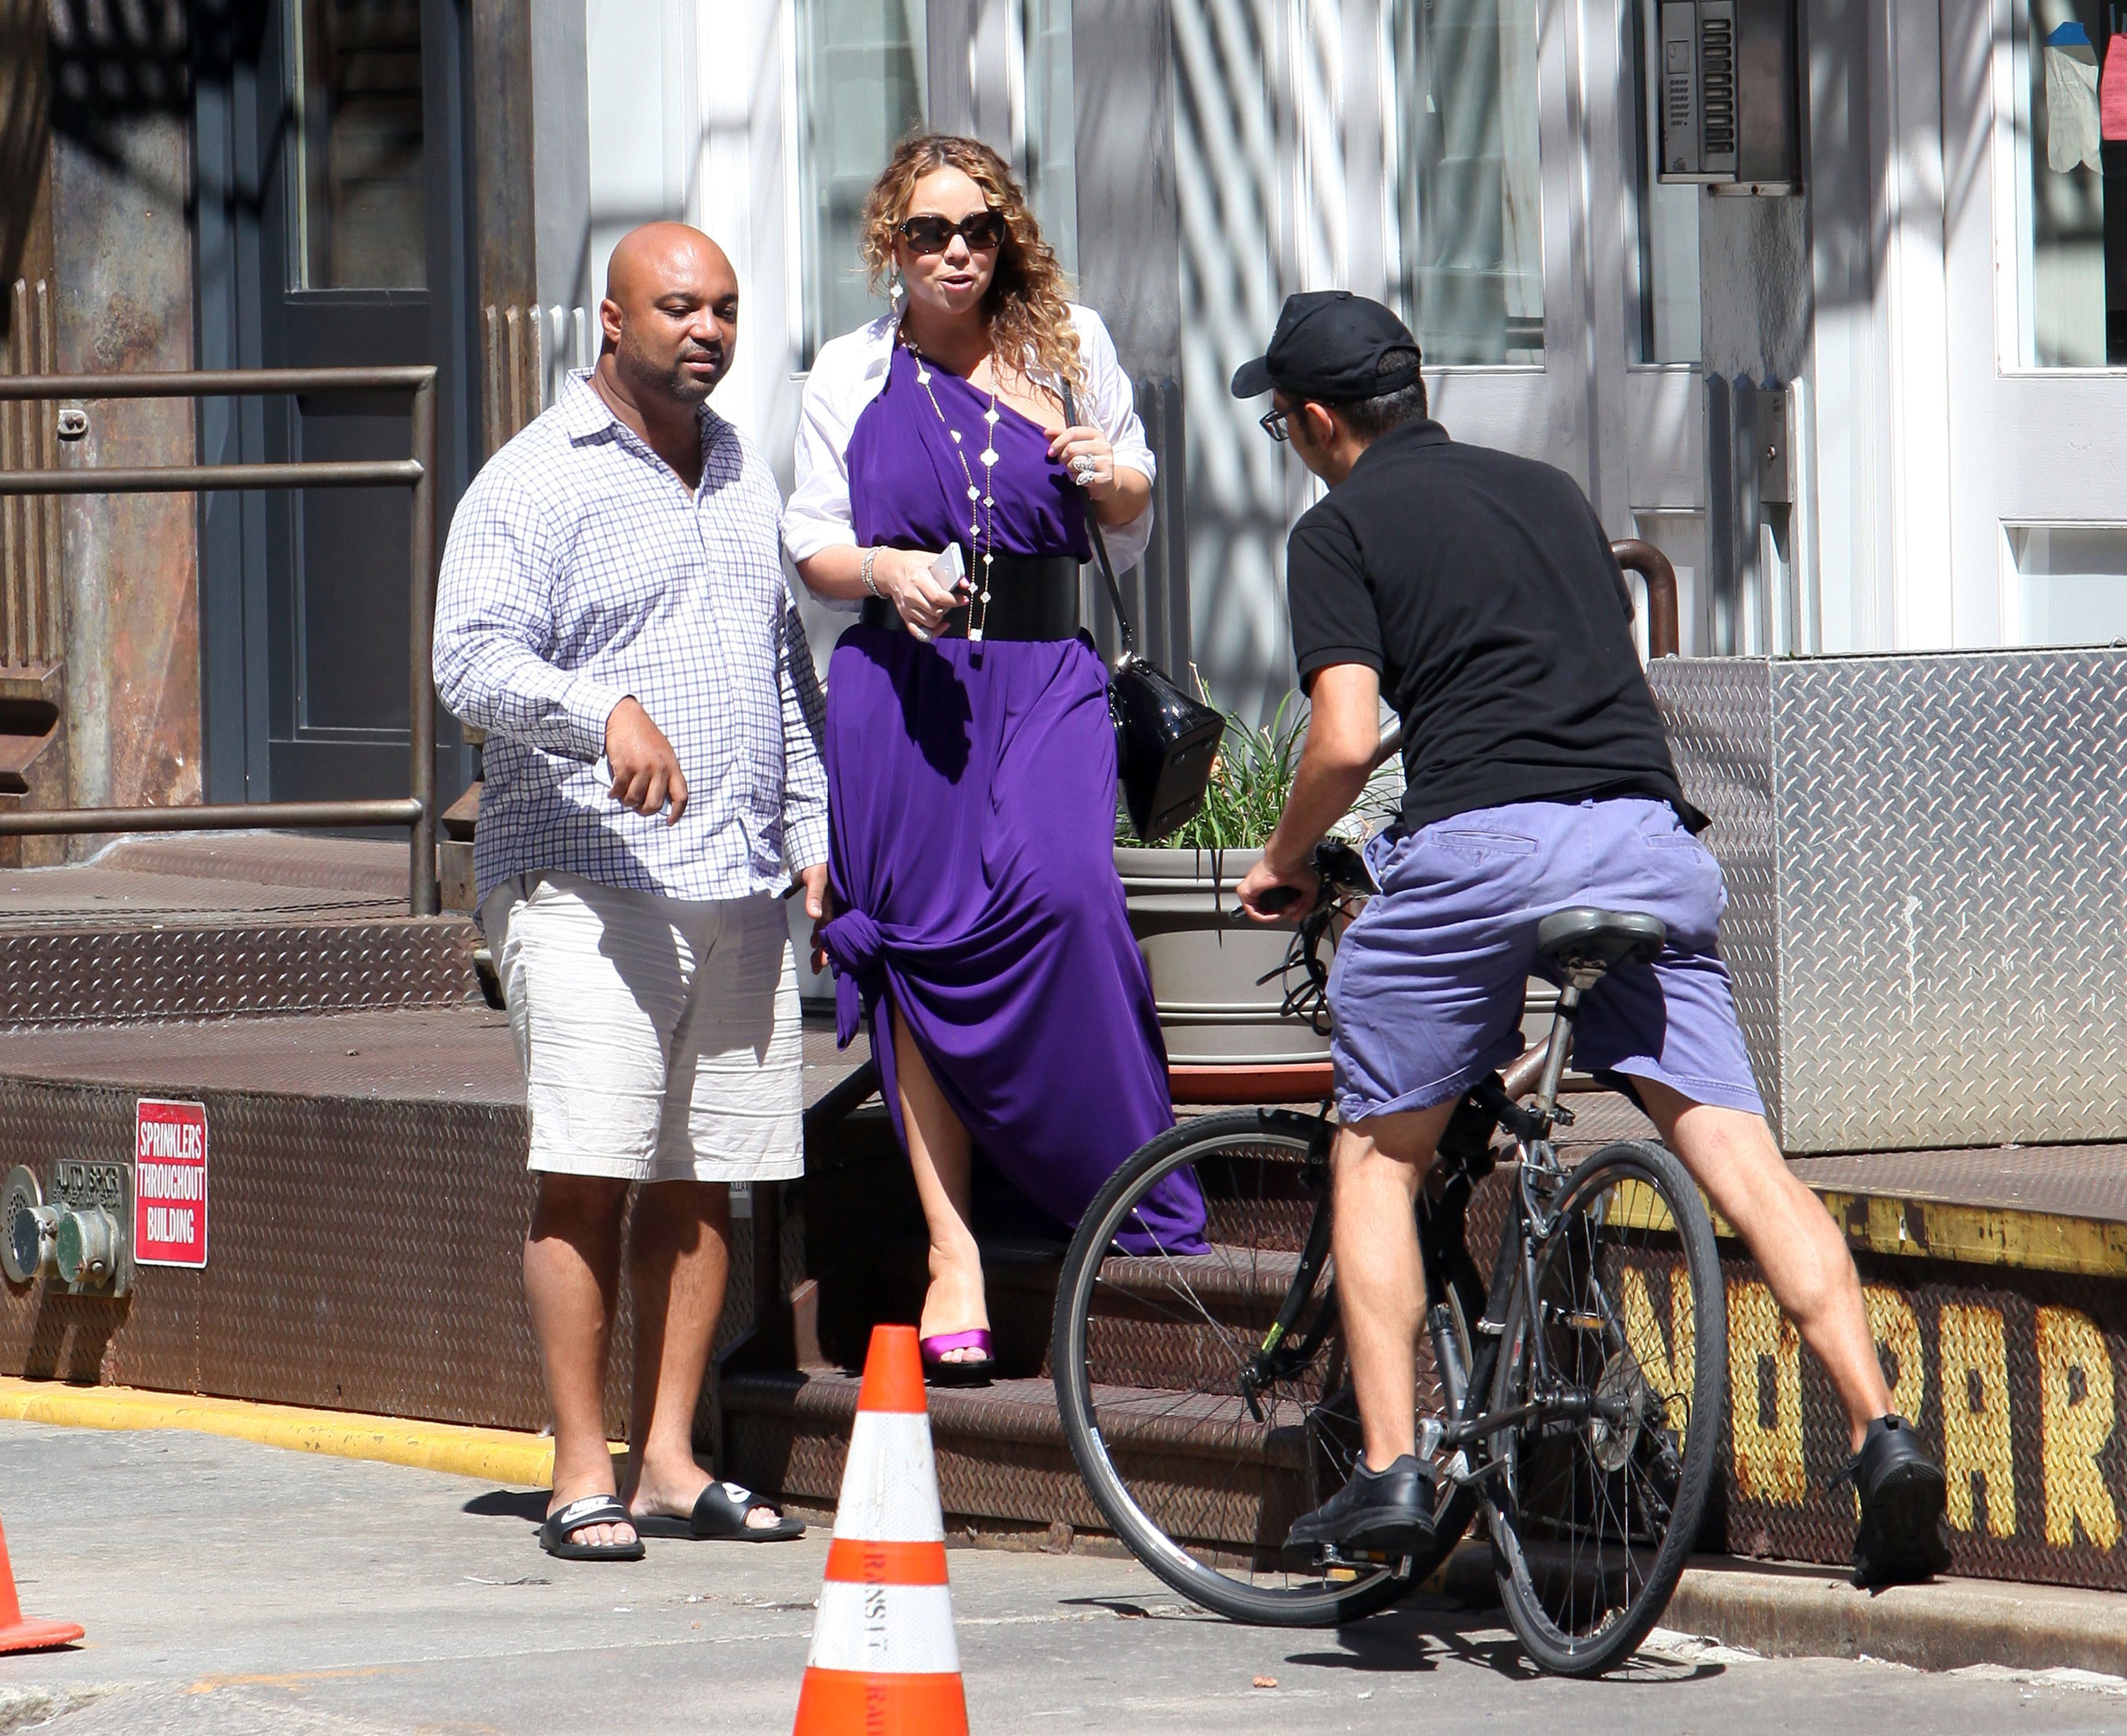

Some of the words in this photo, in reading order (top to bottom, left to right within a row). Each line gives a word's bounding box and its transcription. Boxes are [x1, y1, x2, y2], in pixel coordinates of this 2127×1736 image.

[140, 1121, 202, 1159] SPRINKLERS
[138, 1163, 204, 1201] THROUGHOUT
[147, 1207, 194, 1244] BUILDING
[568, 1496, 610, 1515] NIKE
